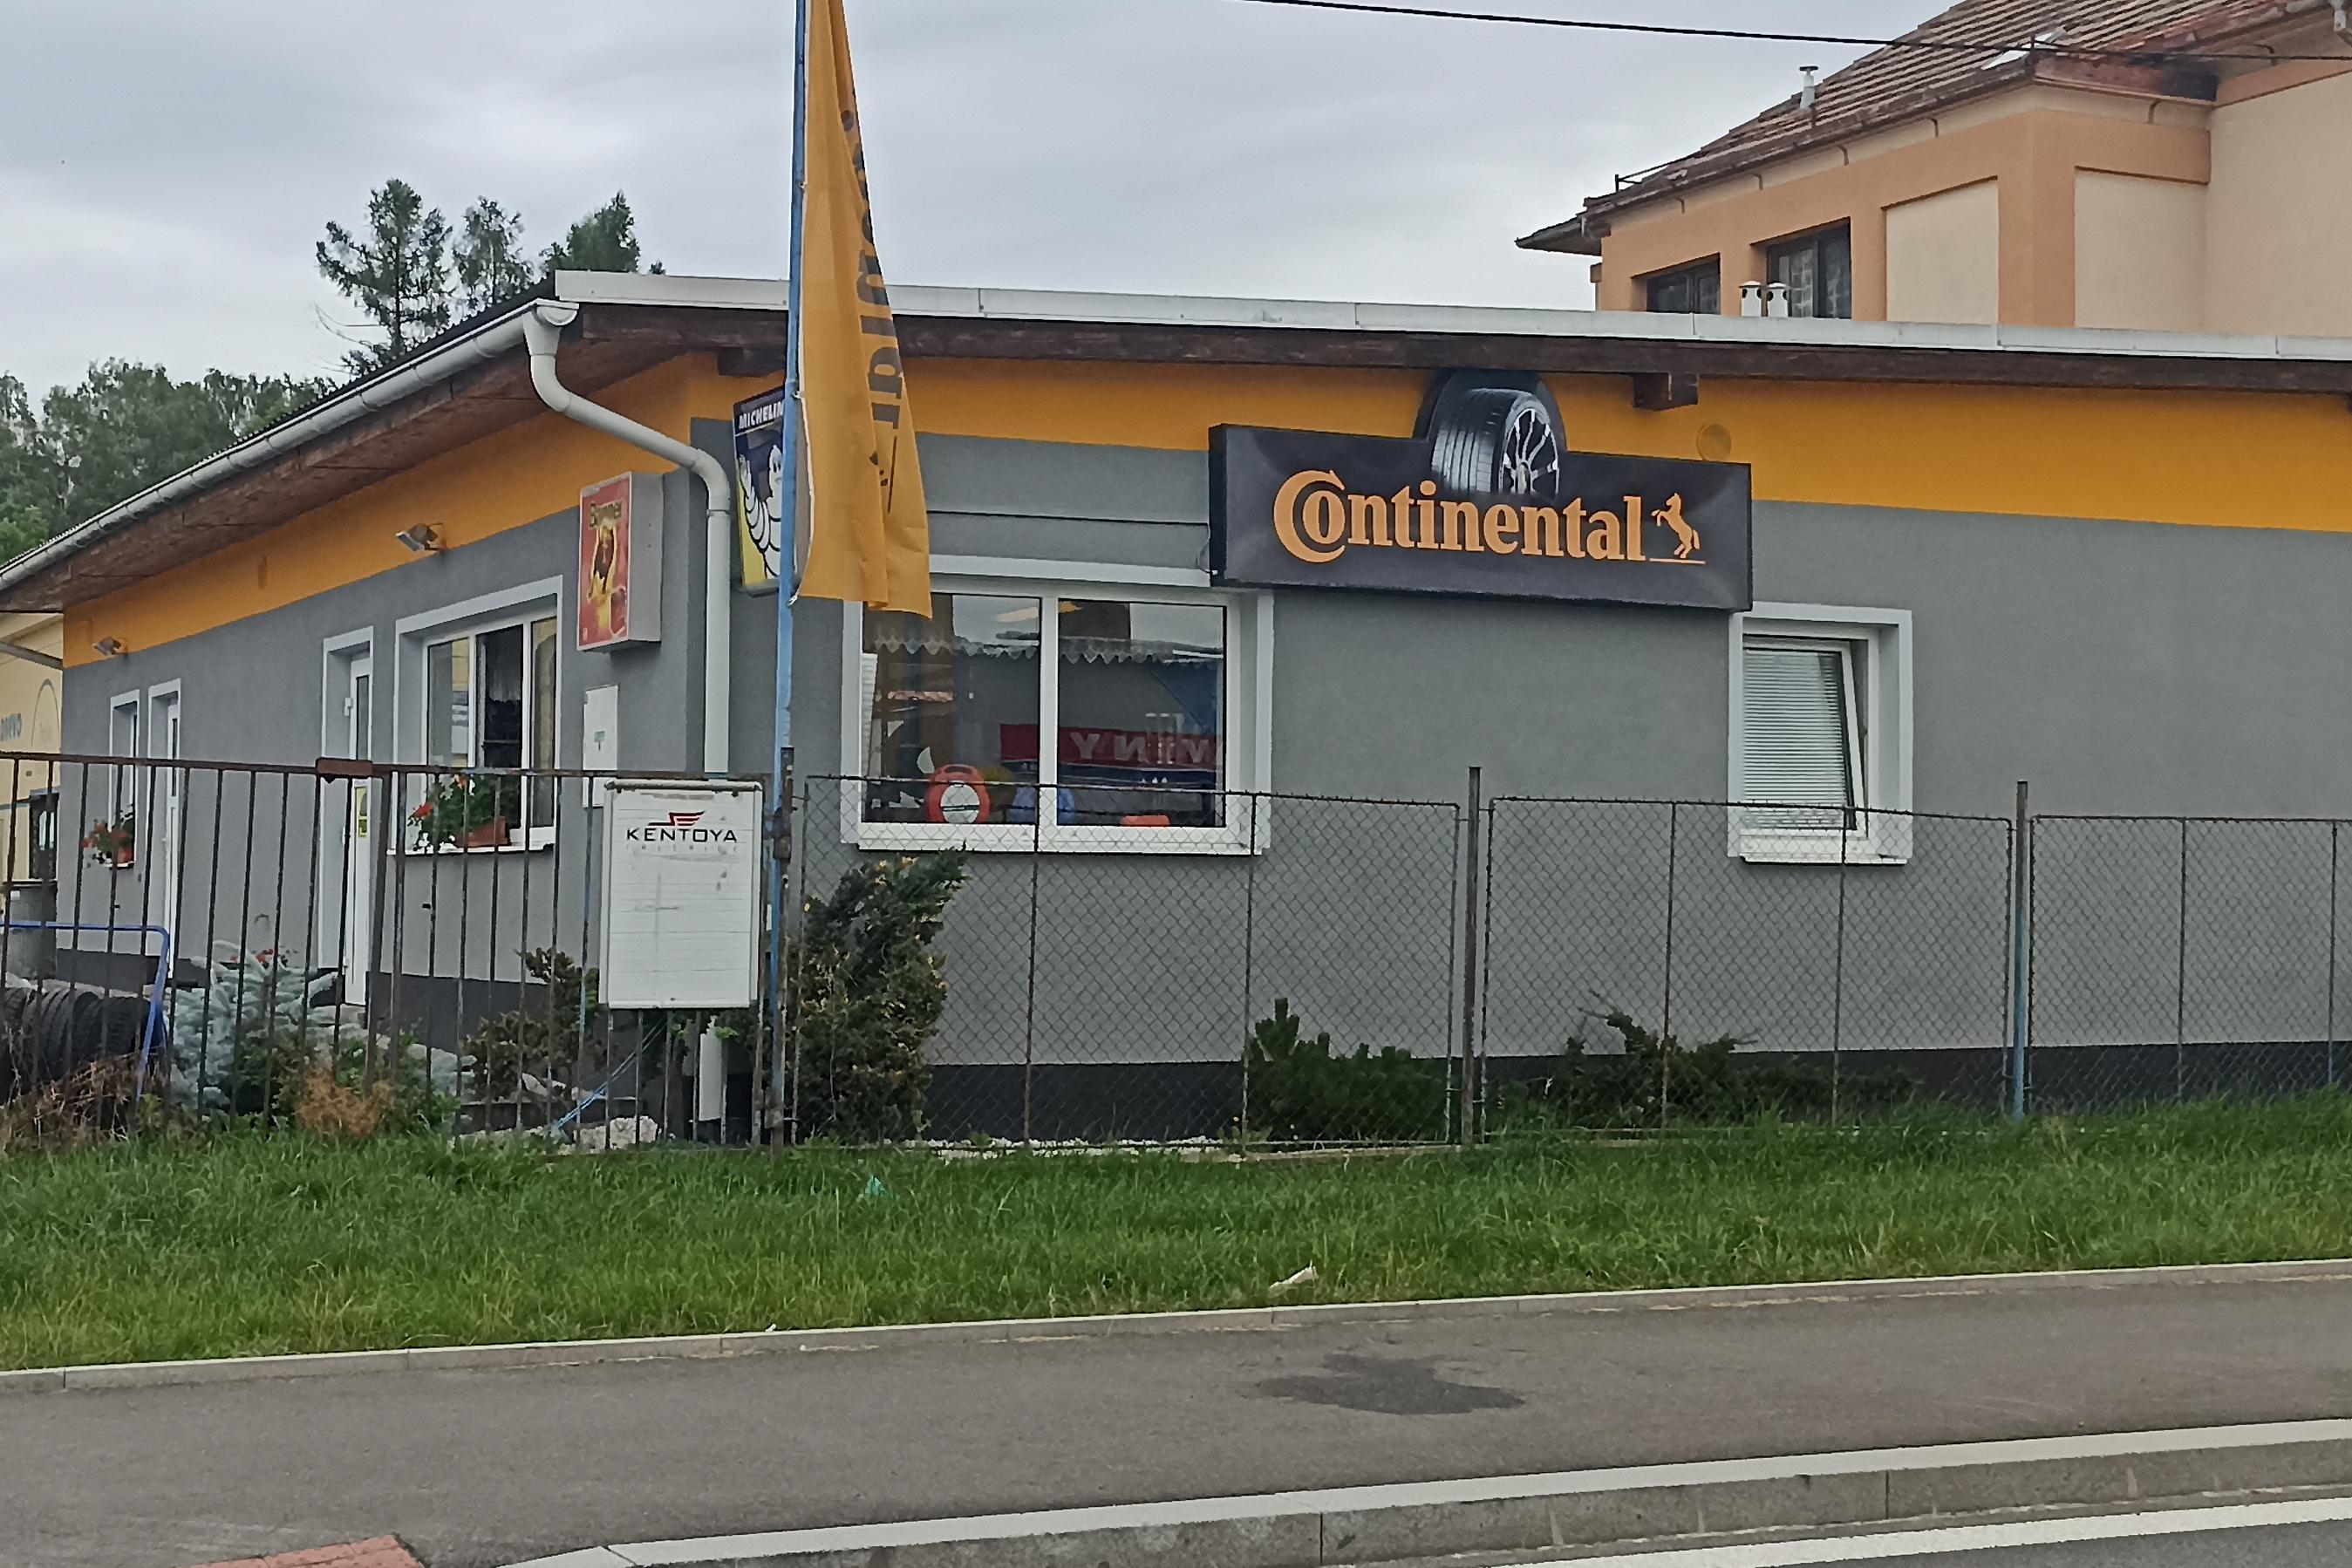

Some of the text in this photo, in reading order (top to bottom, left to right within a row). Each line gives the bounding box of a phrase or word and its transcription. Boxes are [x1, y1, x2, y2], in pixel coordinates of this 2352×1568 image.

[739, 401, 784, 429] MICHELIN
[1273, 469, 1646, 563] Continental
[627, 828, 737, 842] KENTOYA
